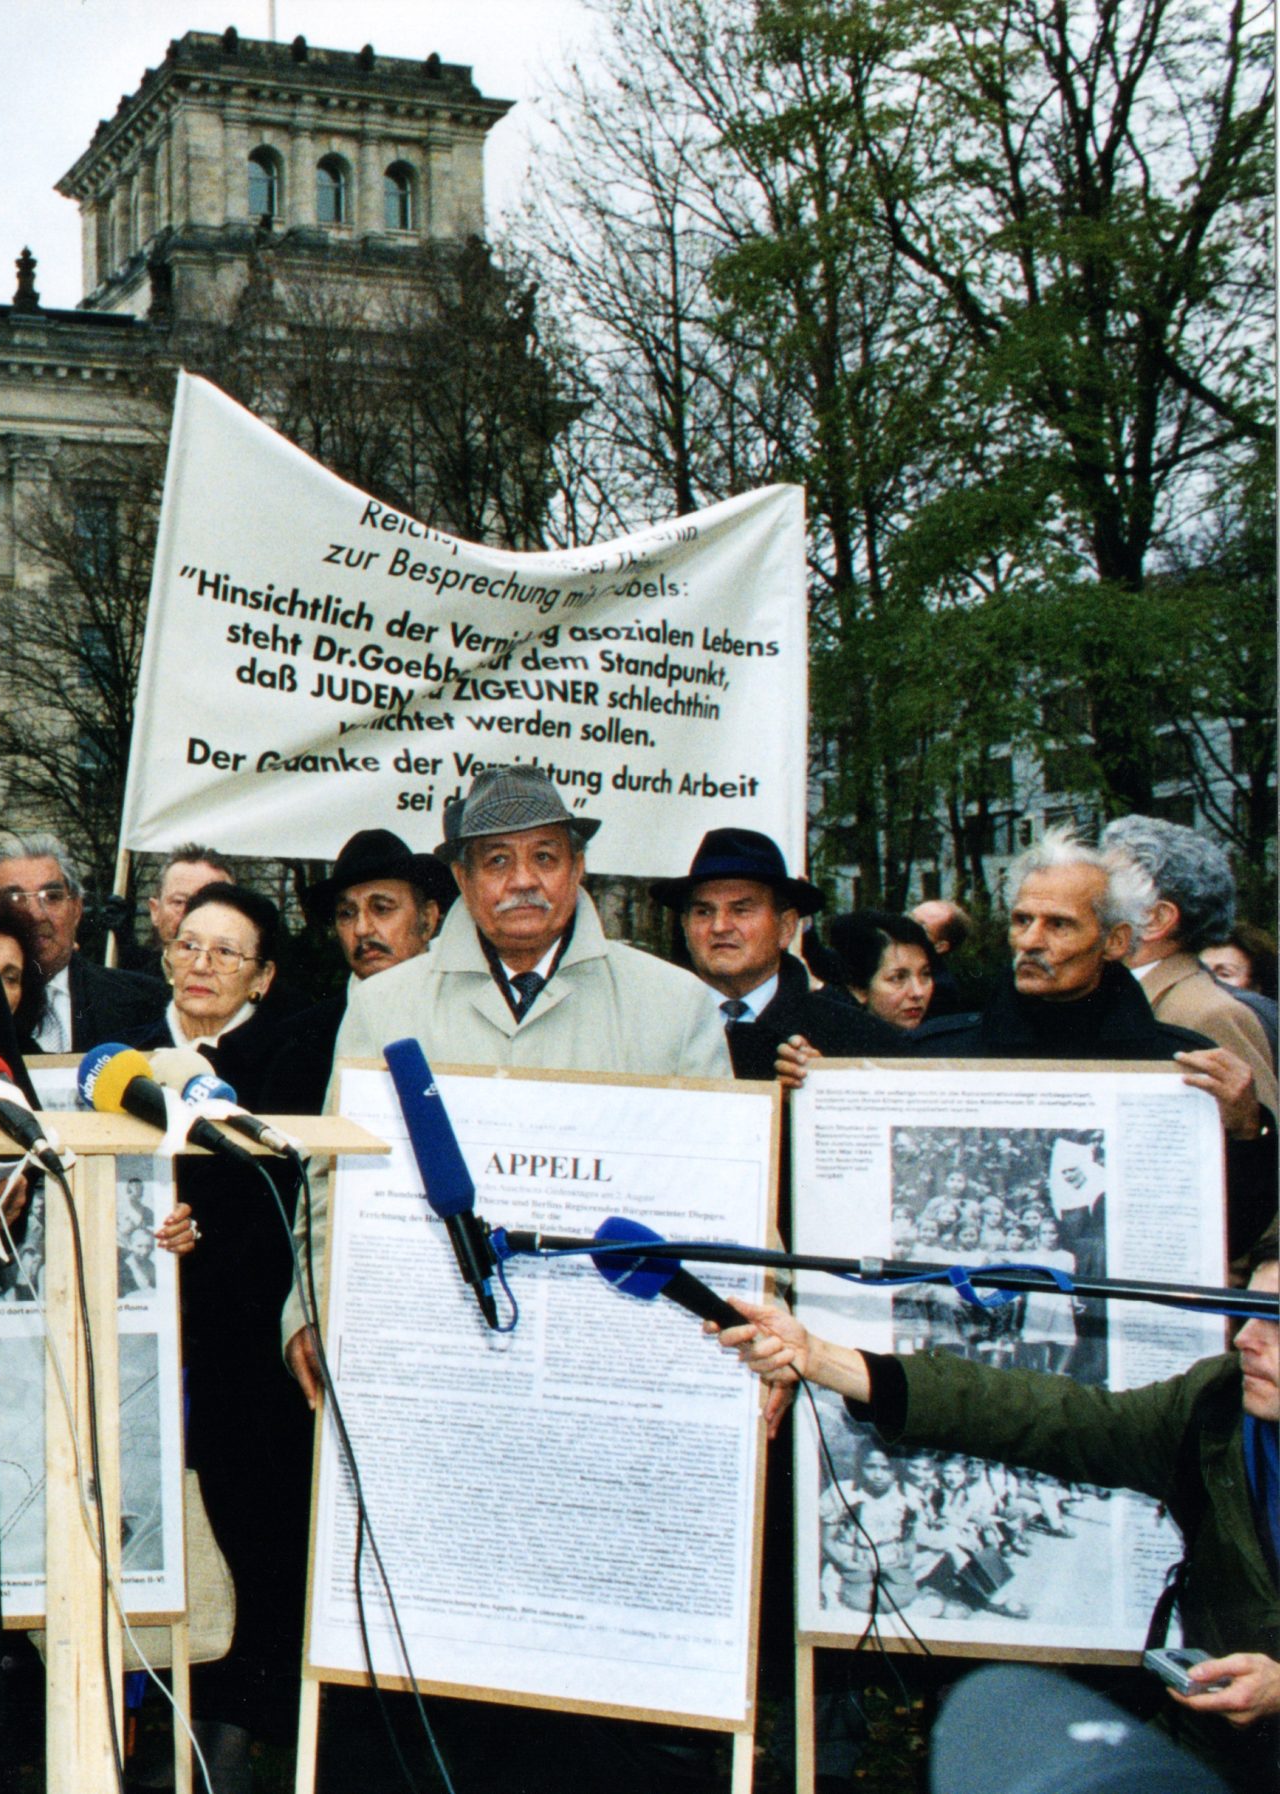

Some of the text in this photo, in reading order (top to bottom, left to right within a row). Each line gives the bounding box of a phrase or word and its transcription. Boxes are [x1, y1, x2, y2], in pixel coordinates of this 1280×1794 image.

[322, 543, 380, 570] zur
[388, 548, 560, 614] Besprechung
[226, 622, 304, 656] steht
[521, 647, 589, 671] dem
[599, 649, 730, 691] Standpunkt,
[385, 609, 441, 645] der
[569, 618, 695, 649] asozialen
[701, 626, 780, 657] Lebens
[236, 658, 299, 694] daß
[310, 672, 414, 712] JUDEN
[453, 676, 600, 707] ZIGEUNER
[607, 684, 720, 720] schlechthin
[466, 708, 572, 739] werden
[580, 716, 656, 747] sollen.
[186, 736, 248, 772] Der
[393, 747, 444, 776] der
[611, 764, 673, 794] durch
[678, 772, 760, 799] Arbeit
[396, 784, 435, 811] sei
[484, 1151, 613, 1183] APPELL
